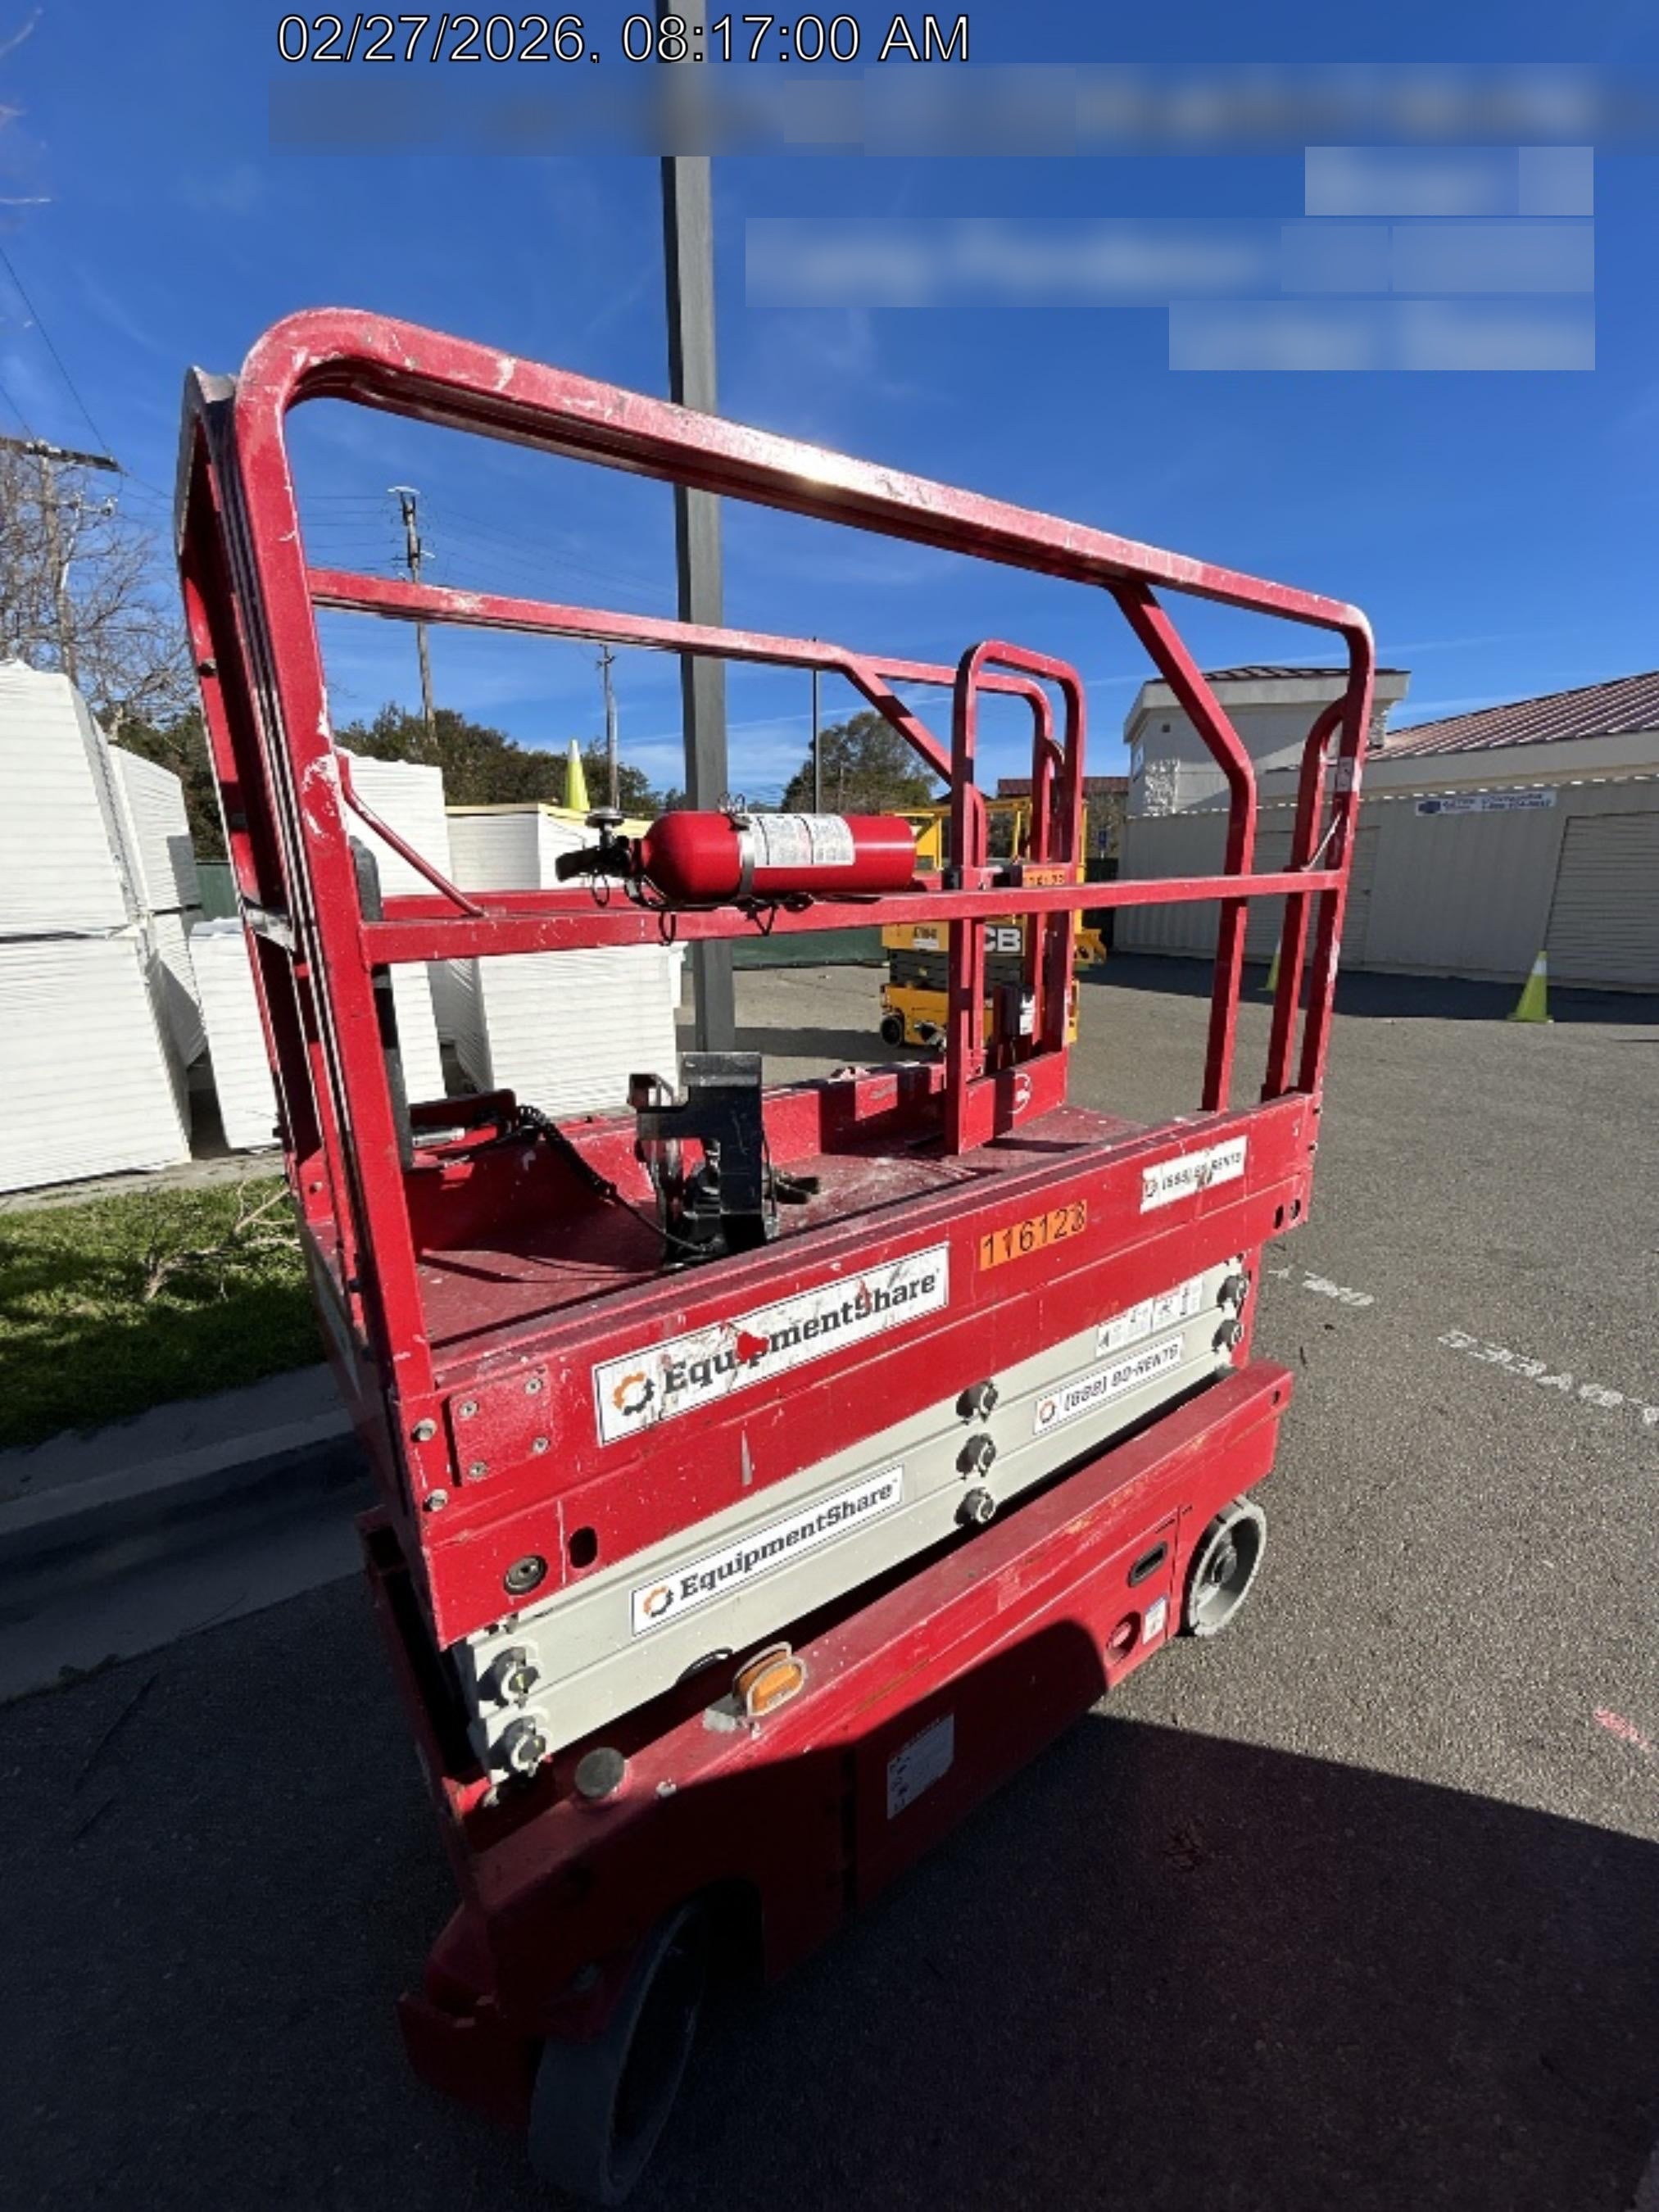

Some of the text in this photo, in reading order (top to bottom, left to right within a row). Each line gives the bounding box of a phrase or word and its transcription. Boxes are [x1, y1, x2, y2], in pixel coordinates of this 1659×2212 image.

[984, 926, 1022, 953] CB
[664, 1272, 936, 1395] EqumentShare
[679, 1483, 893, 1601] EquipmentShare
